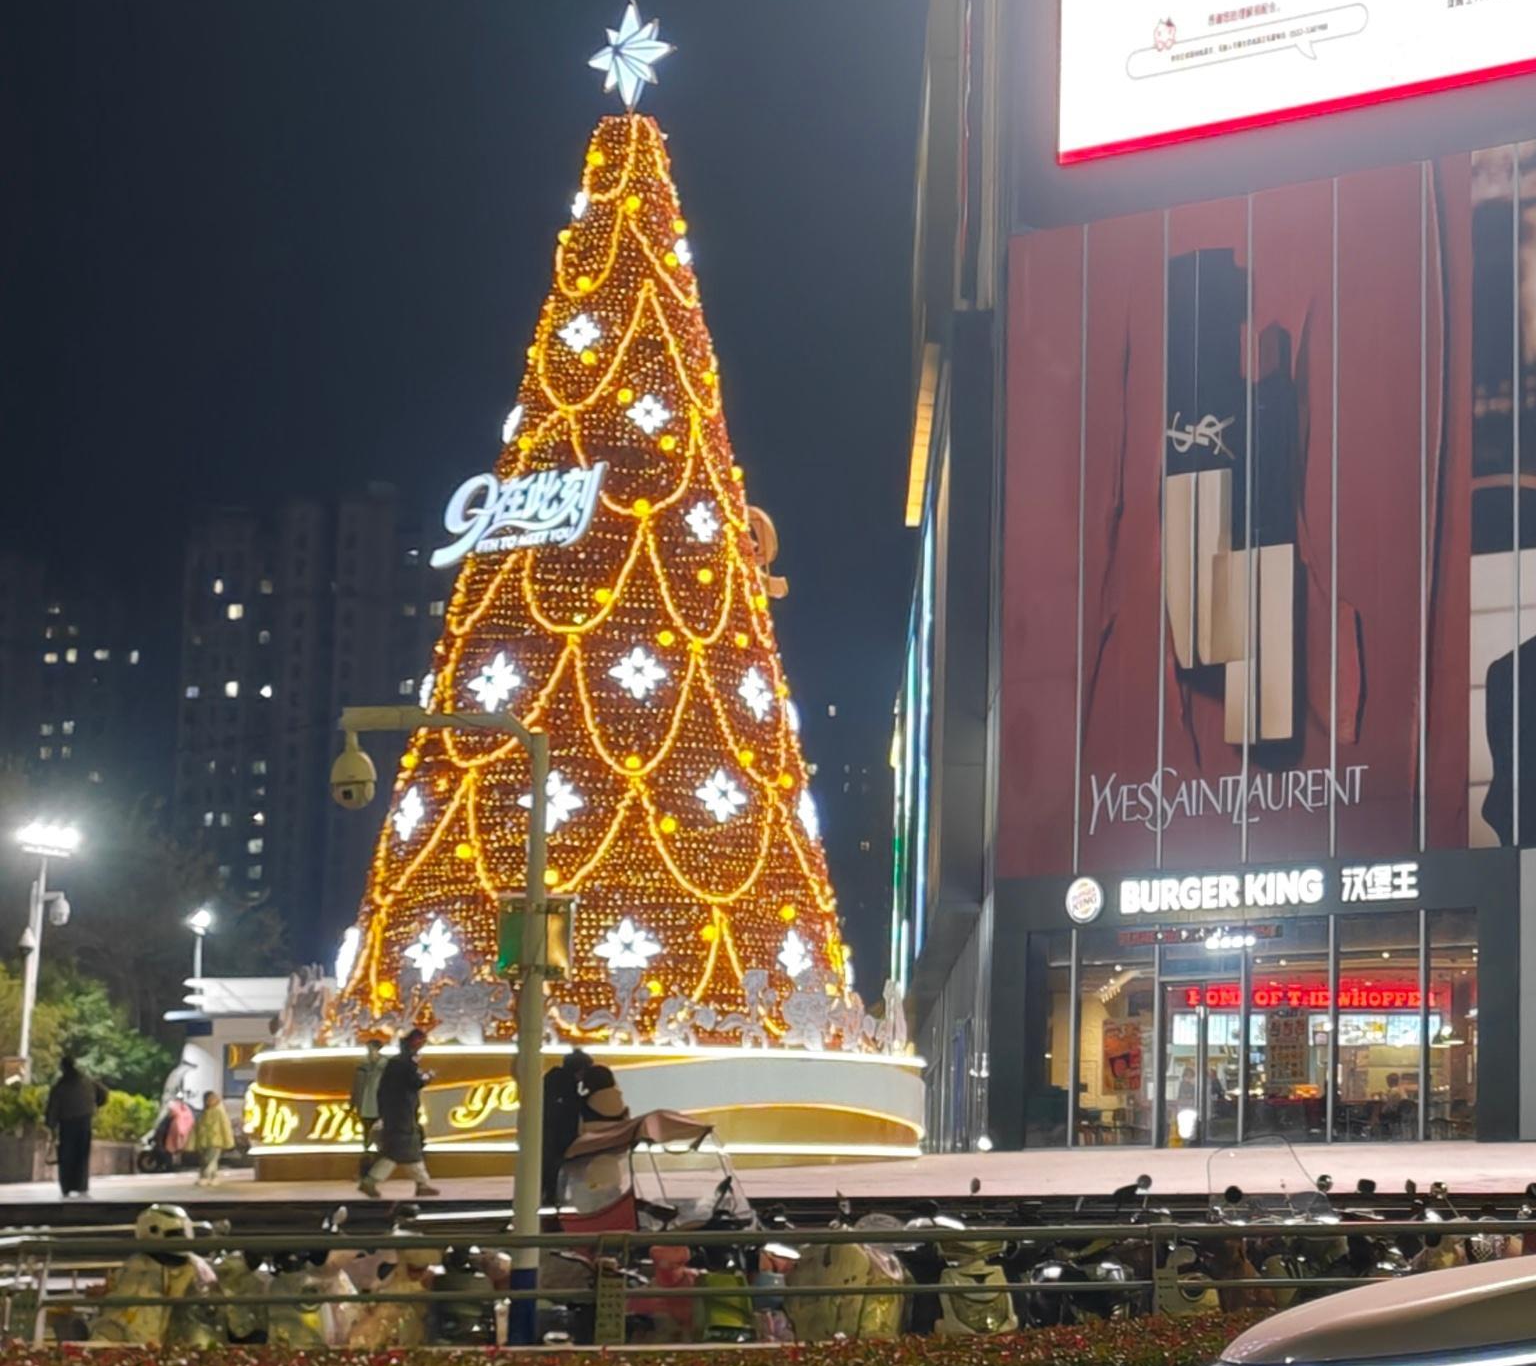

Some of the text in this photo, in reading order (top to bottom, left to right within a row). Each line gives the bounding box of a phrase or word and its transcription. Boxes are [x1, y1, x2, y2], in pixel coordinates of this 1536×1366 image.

[1120, 862, 1420, 914] BURGER KING 汉堡王
[1253, 989, 1284, 1007] OF
